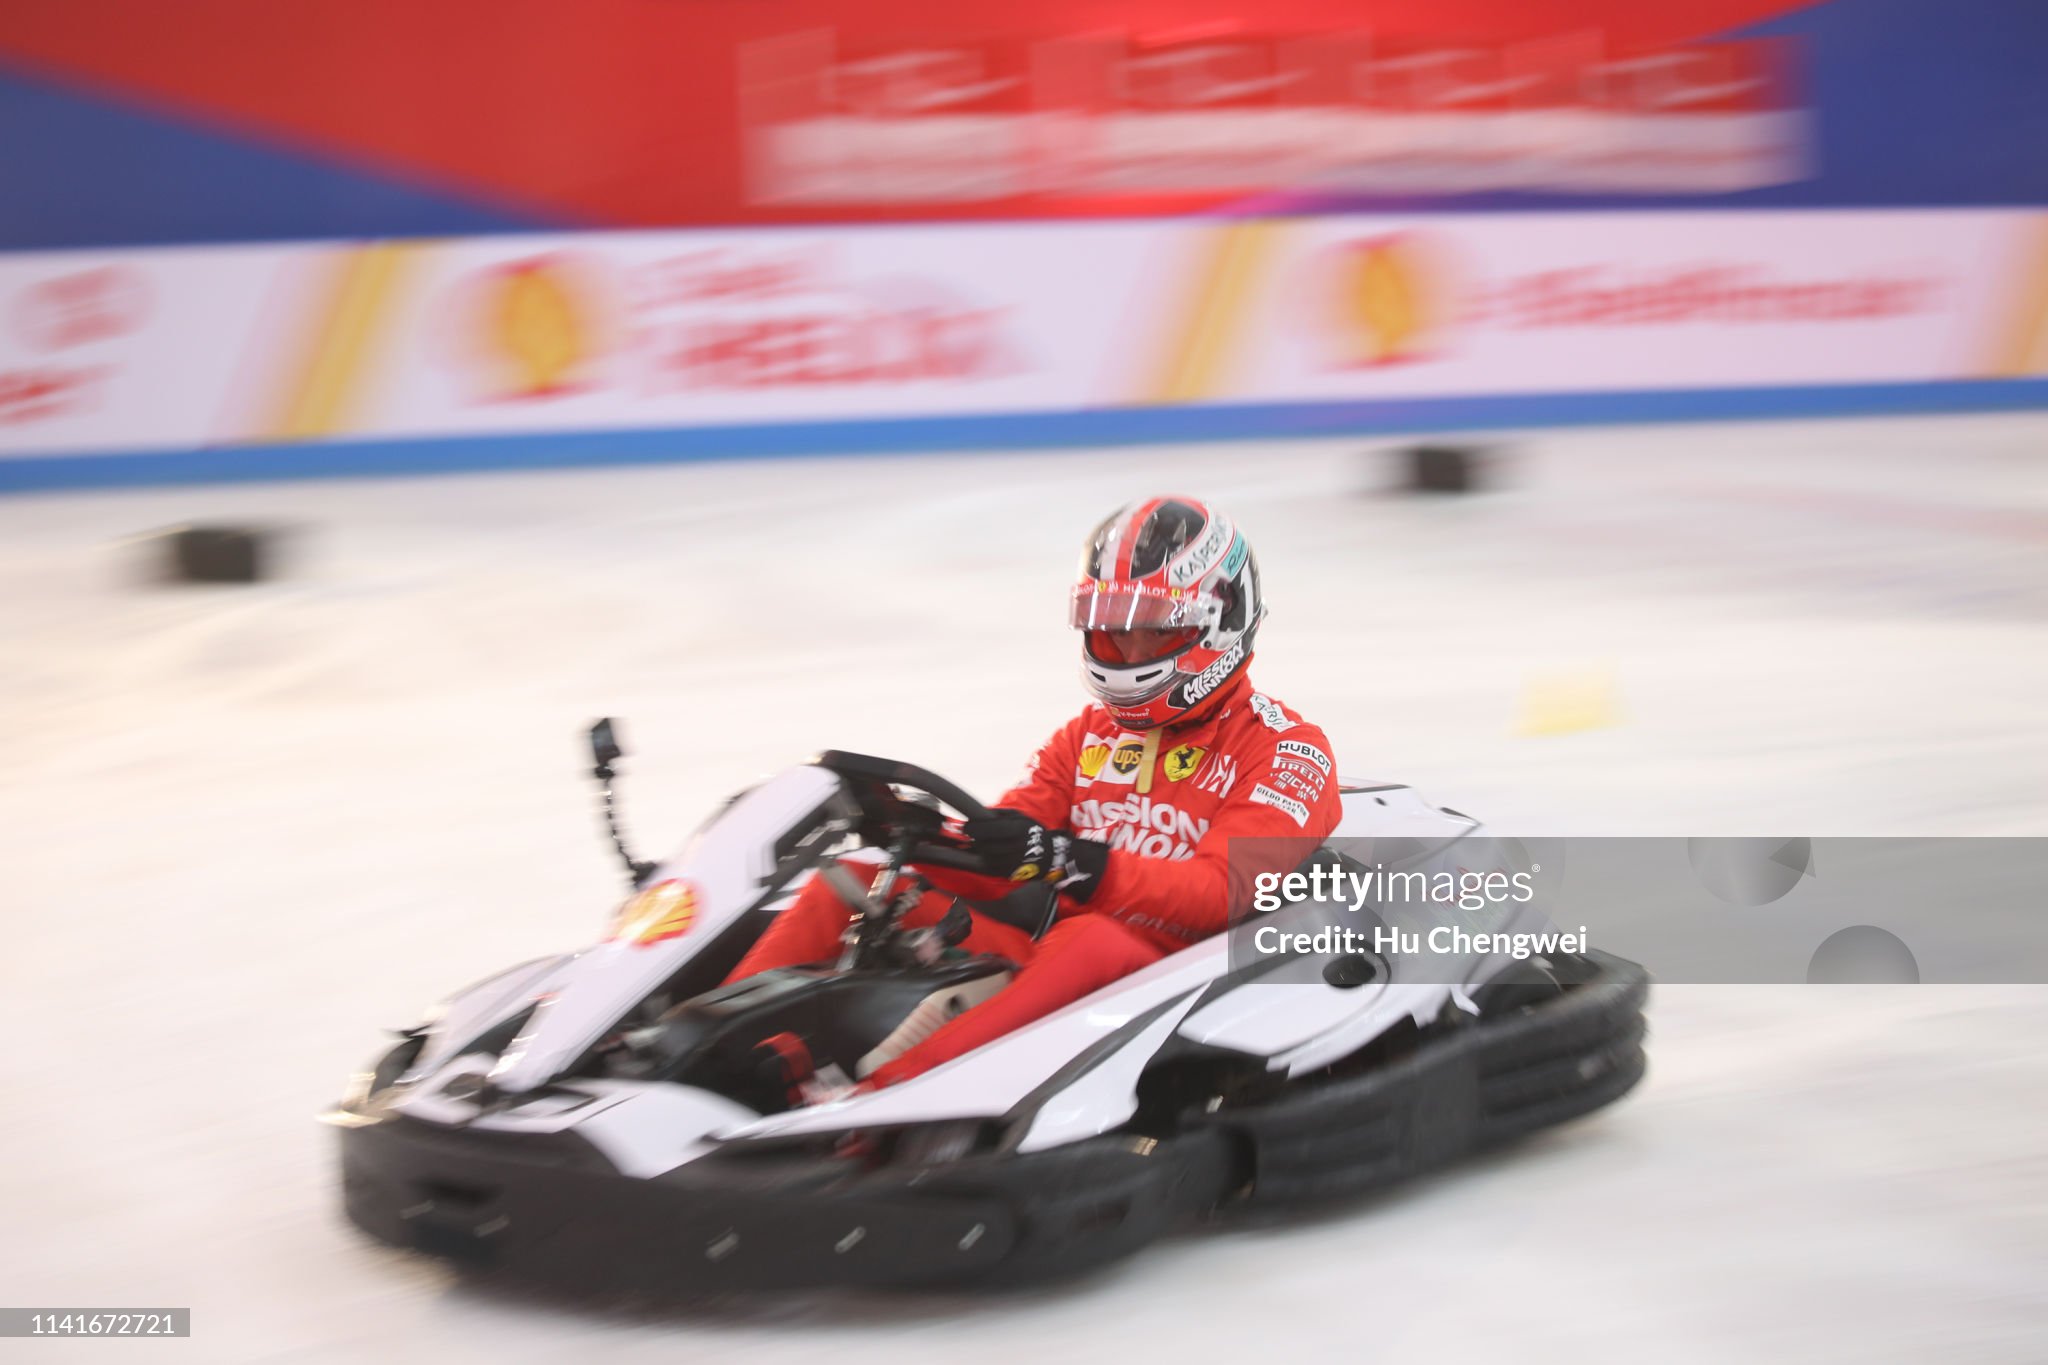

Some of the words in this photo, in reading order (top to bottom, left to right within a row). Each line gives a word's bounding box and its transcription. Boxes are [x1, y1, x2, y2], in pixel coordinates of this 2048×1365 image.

[1184, 639, 1244, 696] MISSION
[1114, 750, 1143, 770] ups
[1278, 741, 1331, 771] HUBLOT
[1257, 787, 1281, 802] GILDO
